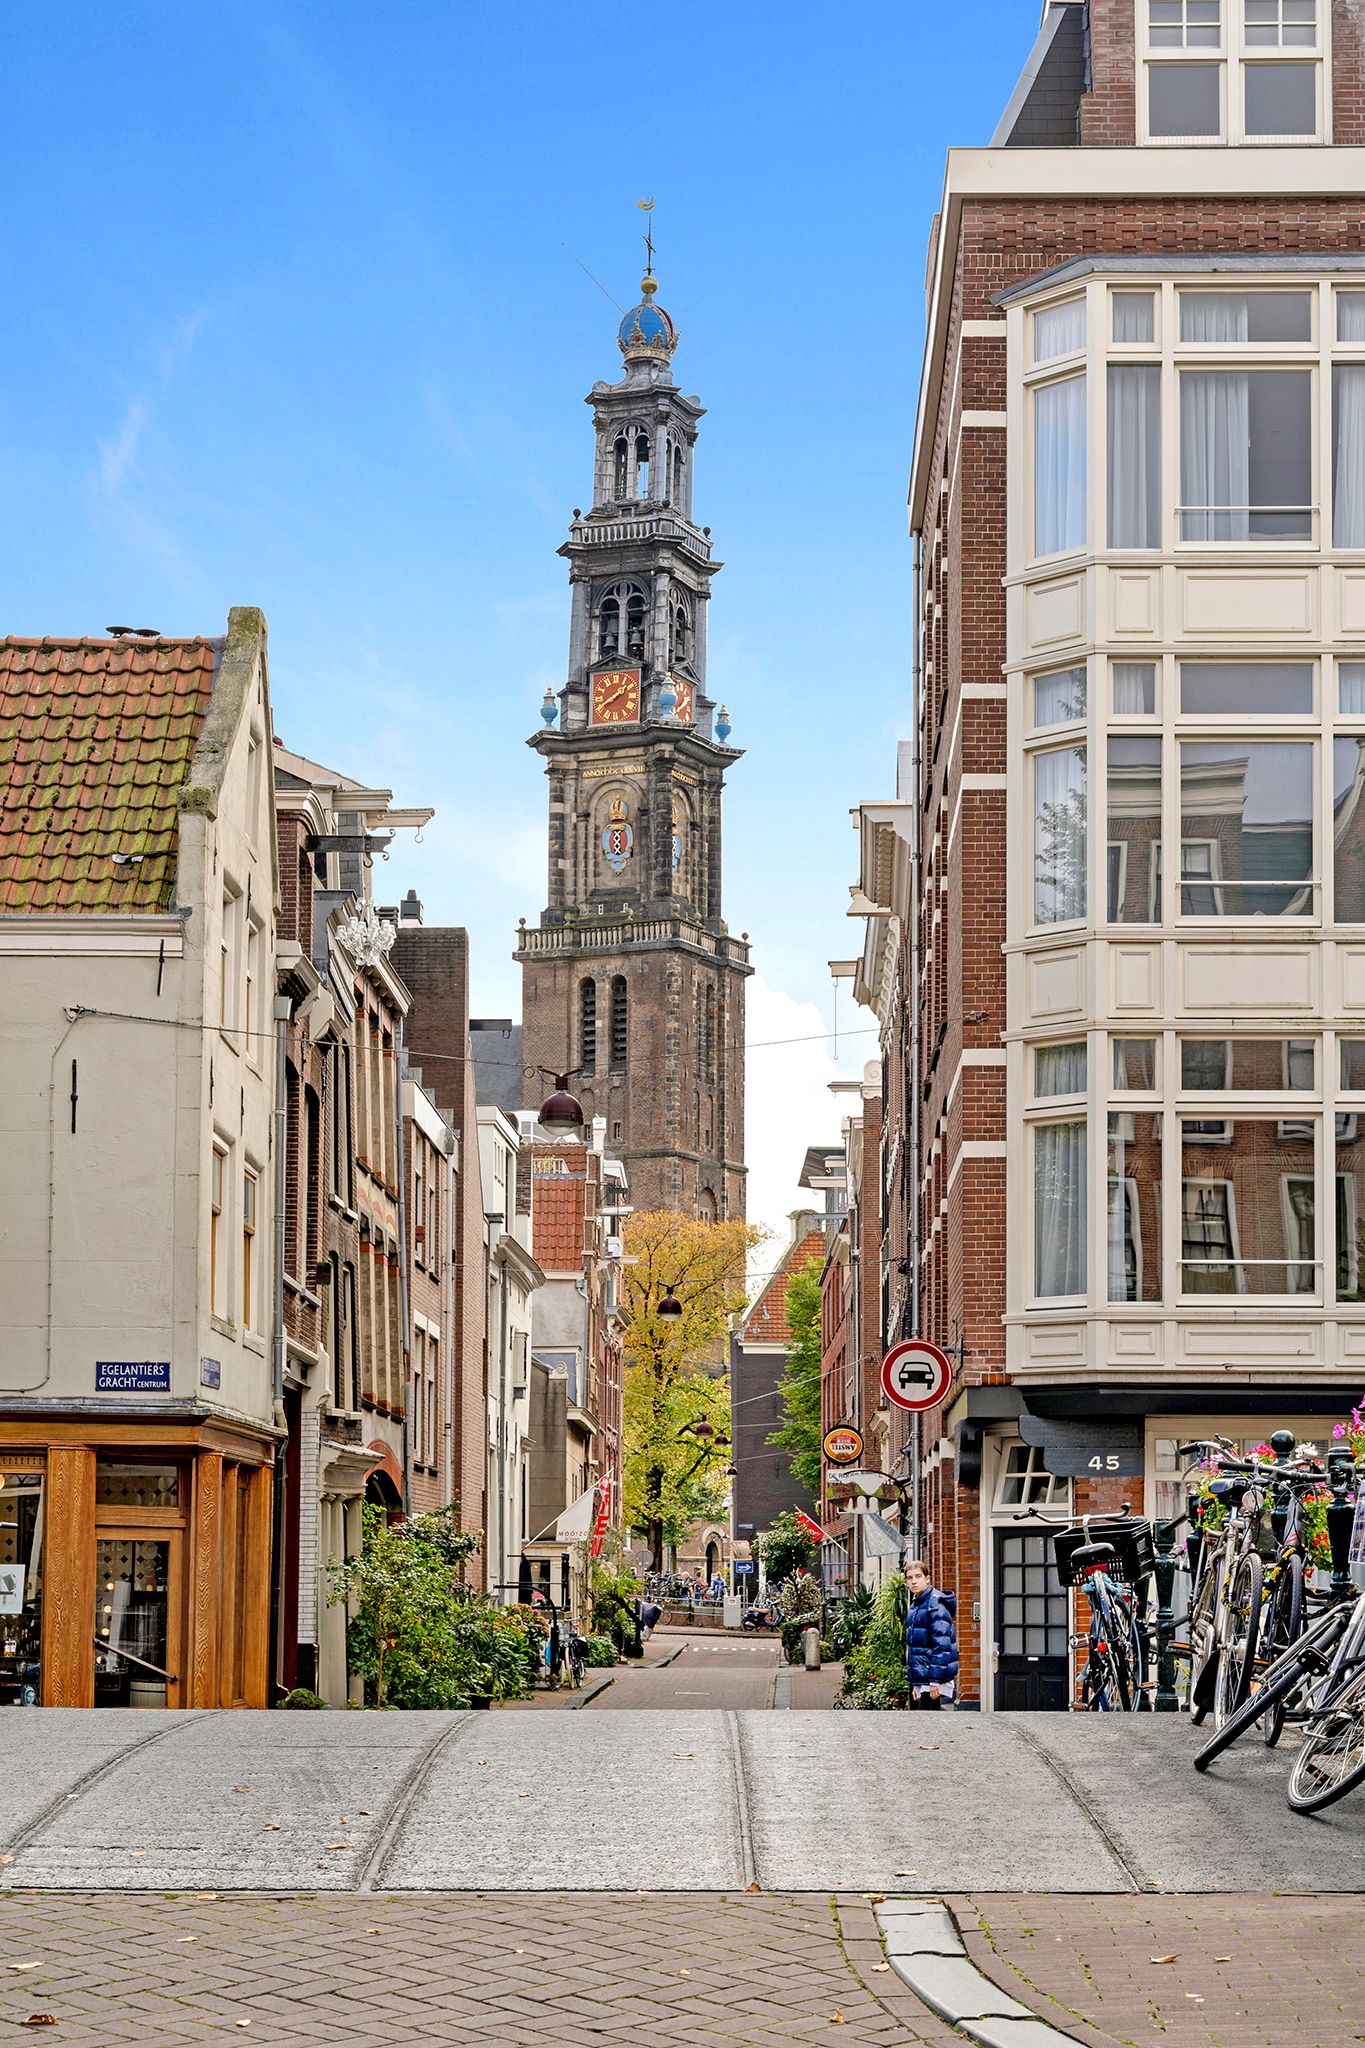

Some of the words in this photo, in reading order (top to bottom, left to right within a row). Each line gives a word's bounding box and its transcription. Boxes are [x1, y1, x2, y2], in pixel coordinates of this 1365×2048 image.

[101, 1365, 164, 1376] EGELANTIERS
[98, 1377, 137, 1388] GRACHT
[1088, 1455, 1120, 1471] 45
